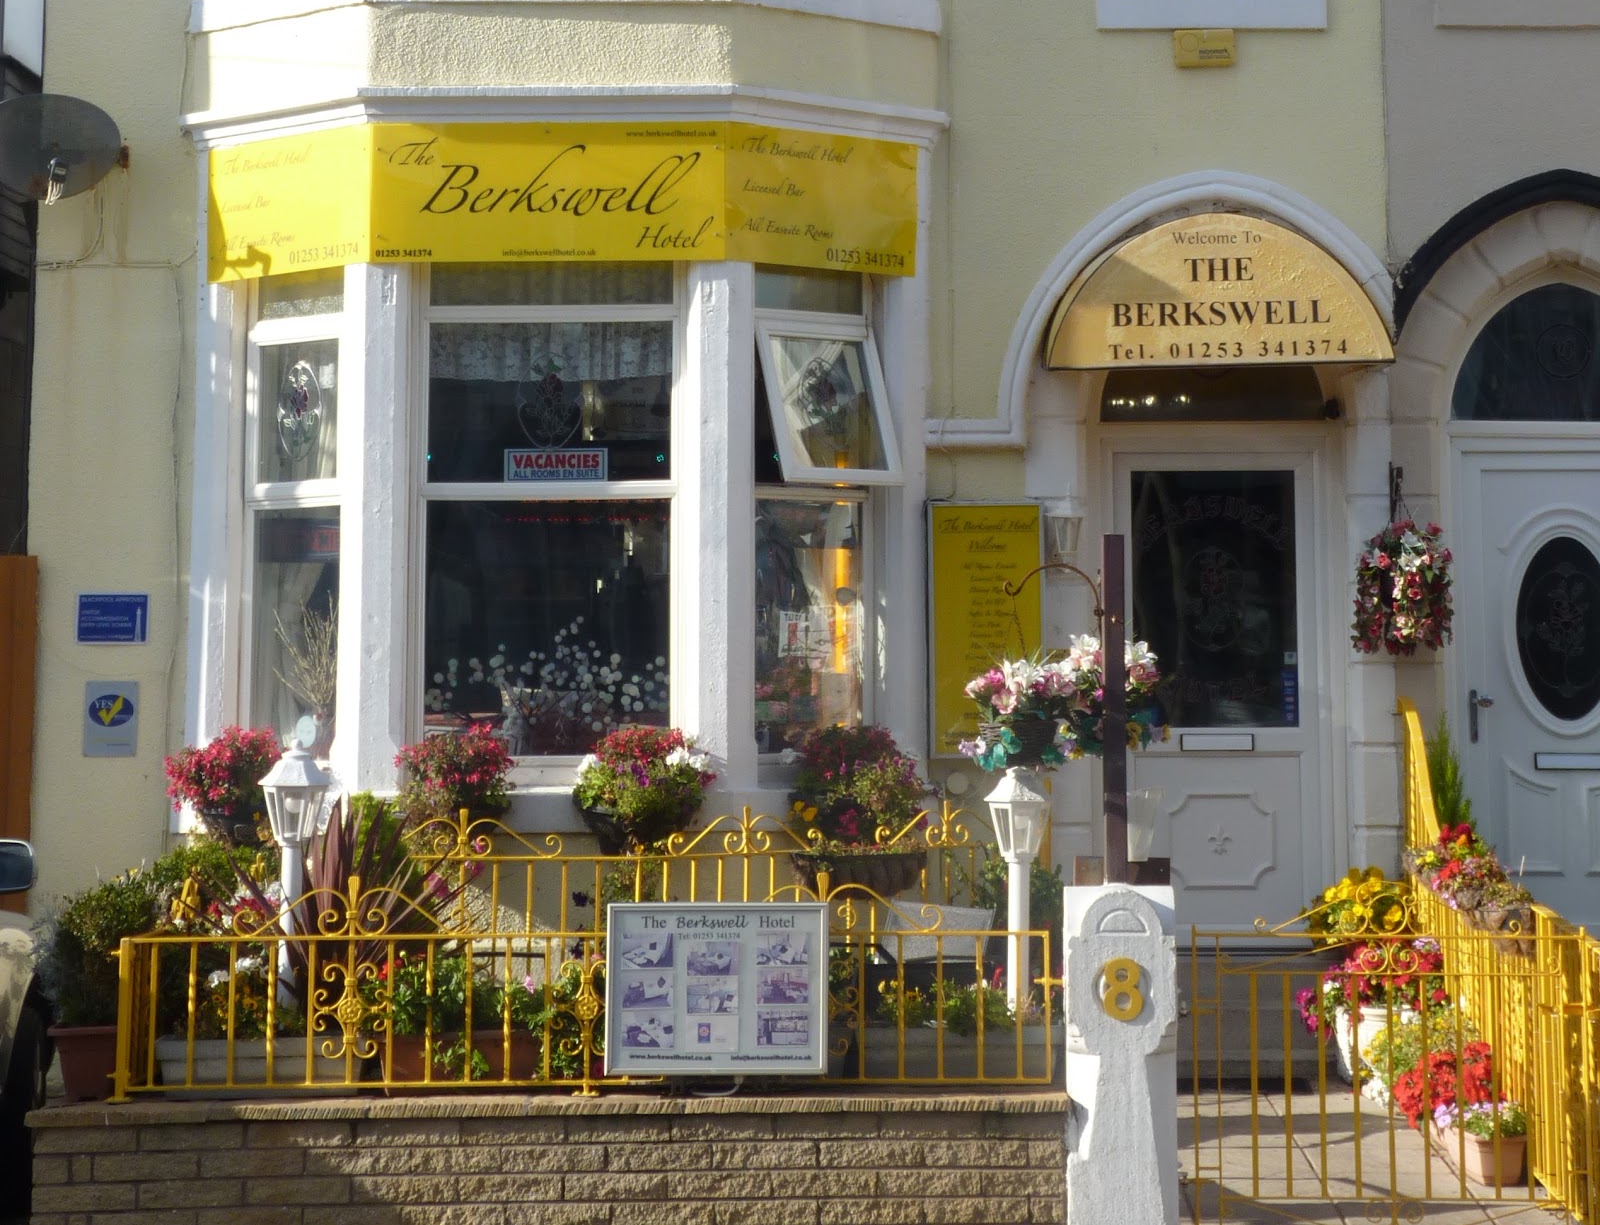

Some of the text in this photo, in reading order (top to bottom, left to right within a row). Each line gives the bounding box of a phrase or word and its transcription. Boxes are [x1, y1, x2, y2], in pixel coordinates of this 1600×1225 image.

[389, 136, 439, 166] The
[741, 136, 853, 164] The Berkswell Hotel
[221, 151, 243, 175] The
[420, 144, 700, 217] Berkswell
[742, 178, 806, 198] Licensed Bar
[255, 192, 271, 209] Bar
[636, 216, 714, 249] Hotel
[742, 217, 834, 242] All Ensuite Rooms
[1172, 230, 1263, 245] Welcome To
[289, 243, 359, 264] 01253 341374
[375, 249, 432, 258] 01253 341374
[826, 248, 905, 268] 01253 341374
[1183, 257, 1254, 283] THE
[1112, 299, 1332, 327] BERKSWELL
[1109, 339, 1349, 360] Tel. 01253 341374
[512, 454, 600, 469] VACANCIES
[513, 469, 600, 478] ALL ROOMS EN SUITE
[94, 700, 113, 709] YES
[641, 915, 795, 929] The Berkswell Hotel
[1103, 957, 1144, 1022] 8
